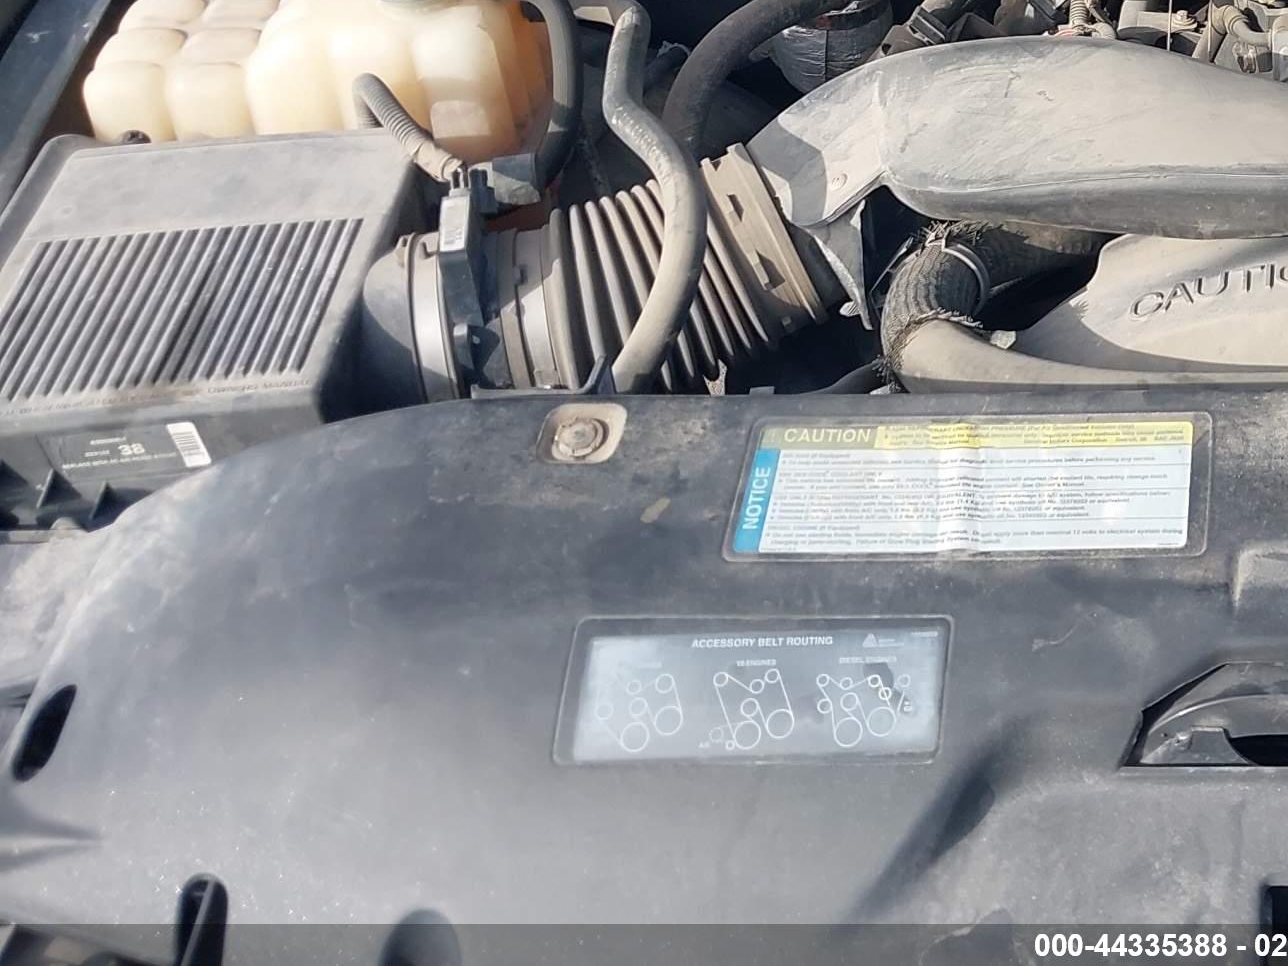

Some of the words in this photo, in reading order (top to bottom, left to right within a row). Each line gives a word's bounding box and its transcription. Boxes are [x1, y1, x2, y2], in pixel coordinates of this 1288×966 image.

[783, 428, 871, 443] CAUTION
[117, 442, 145, 455] 38
[742, 466, 771, 530] NOTICE
[691, 638, 756, 649] ACCESSORY
[758, 637, 785, 647] BELT
[786, 636, 833, 646] ROUTING
